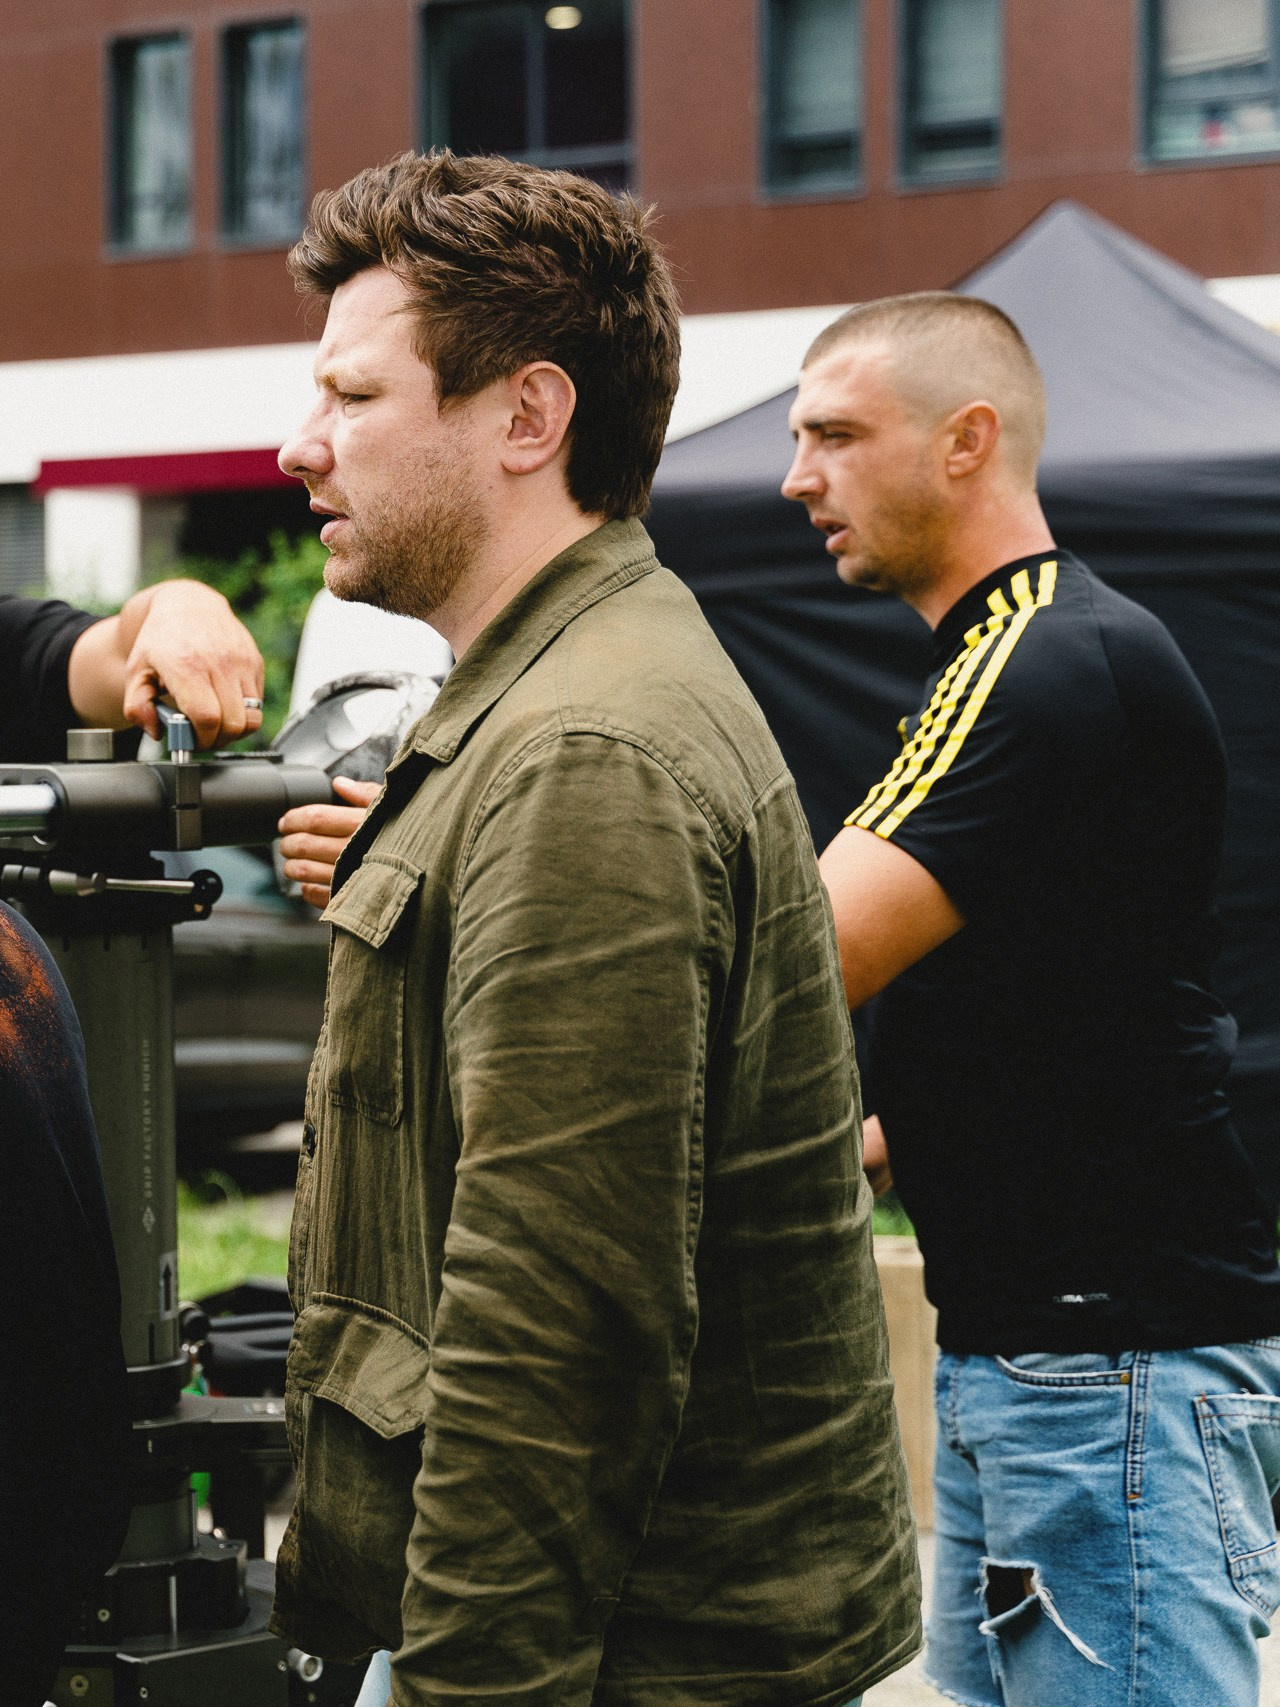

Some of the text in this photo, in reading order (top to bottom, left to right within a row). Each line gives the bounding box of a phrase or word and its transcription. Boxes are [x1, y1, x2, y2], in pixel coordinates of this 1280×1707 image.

[142, 1038, 152, 1198] GRIP FACTORY MUNICH
